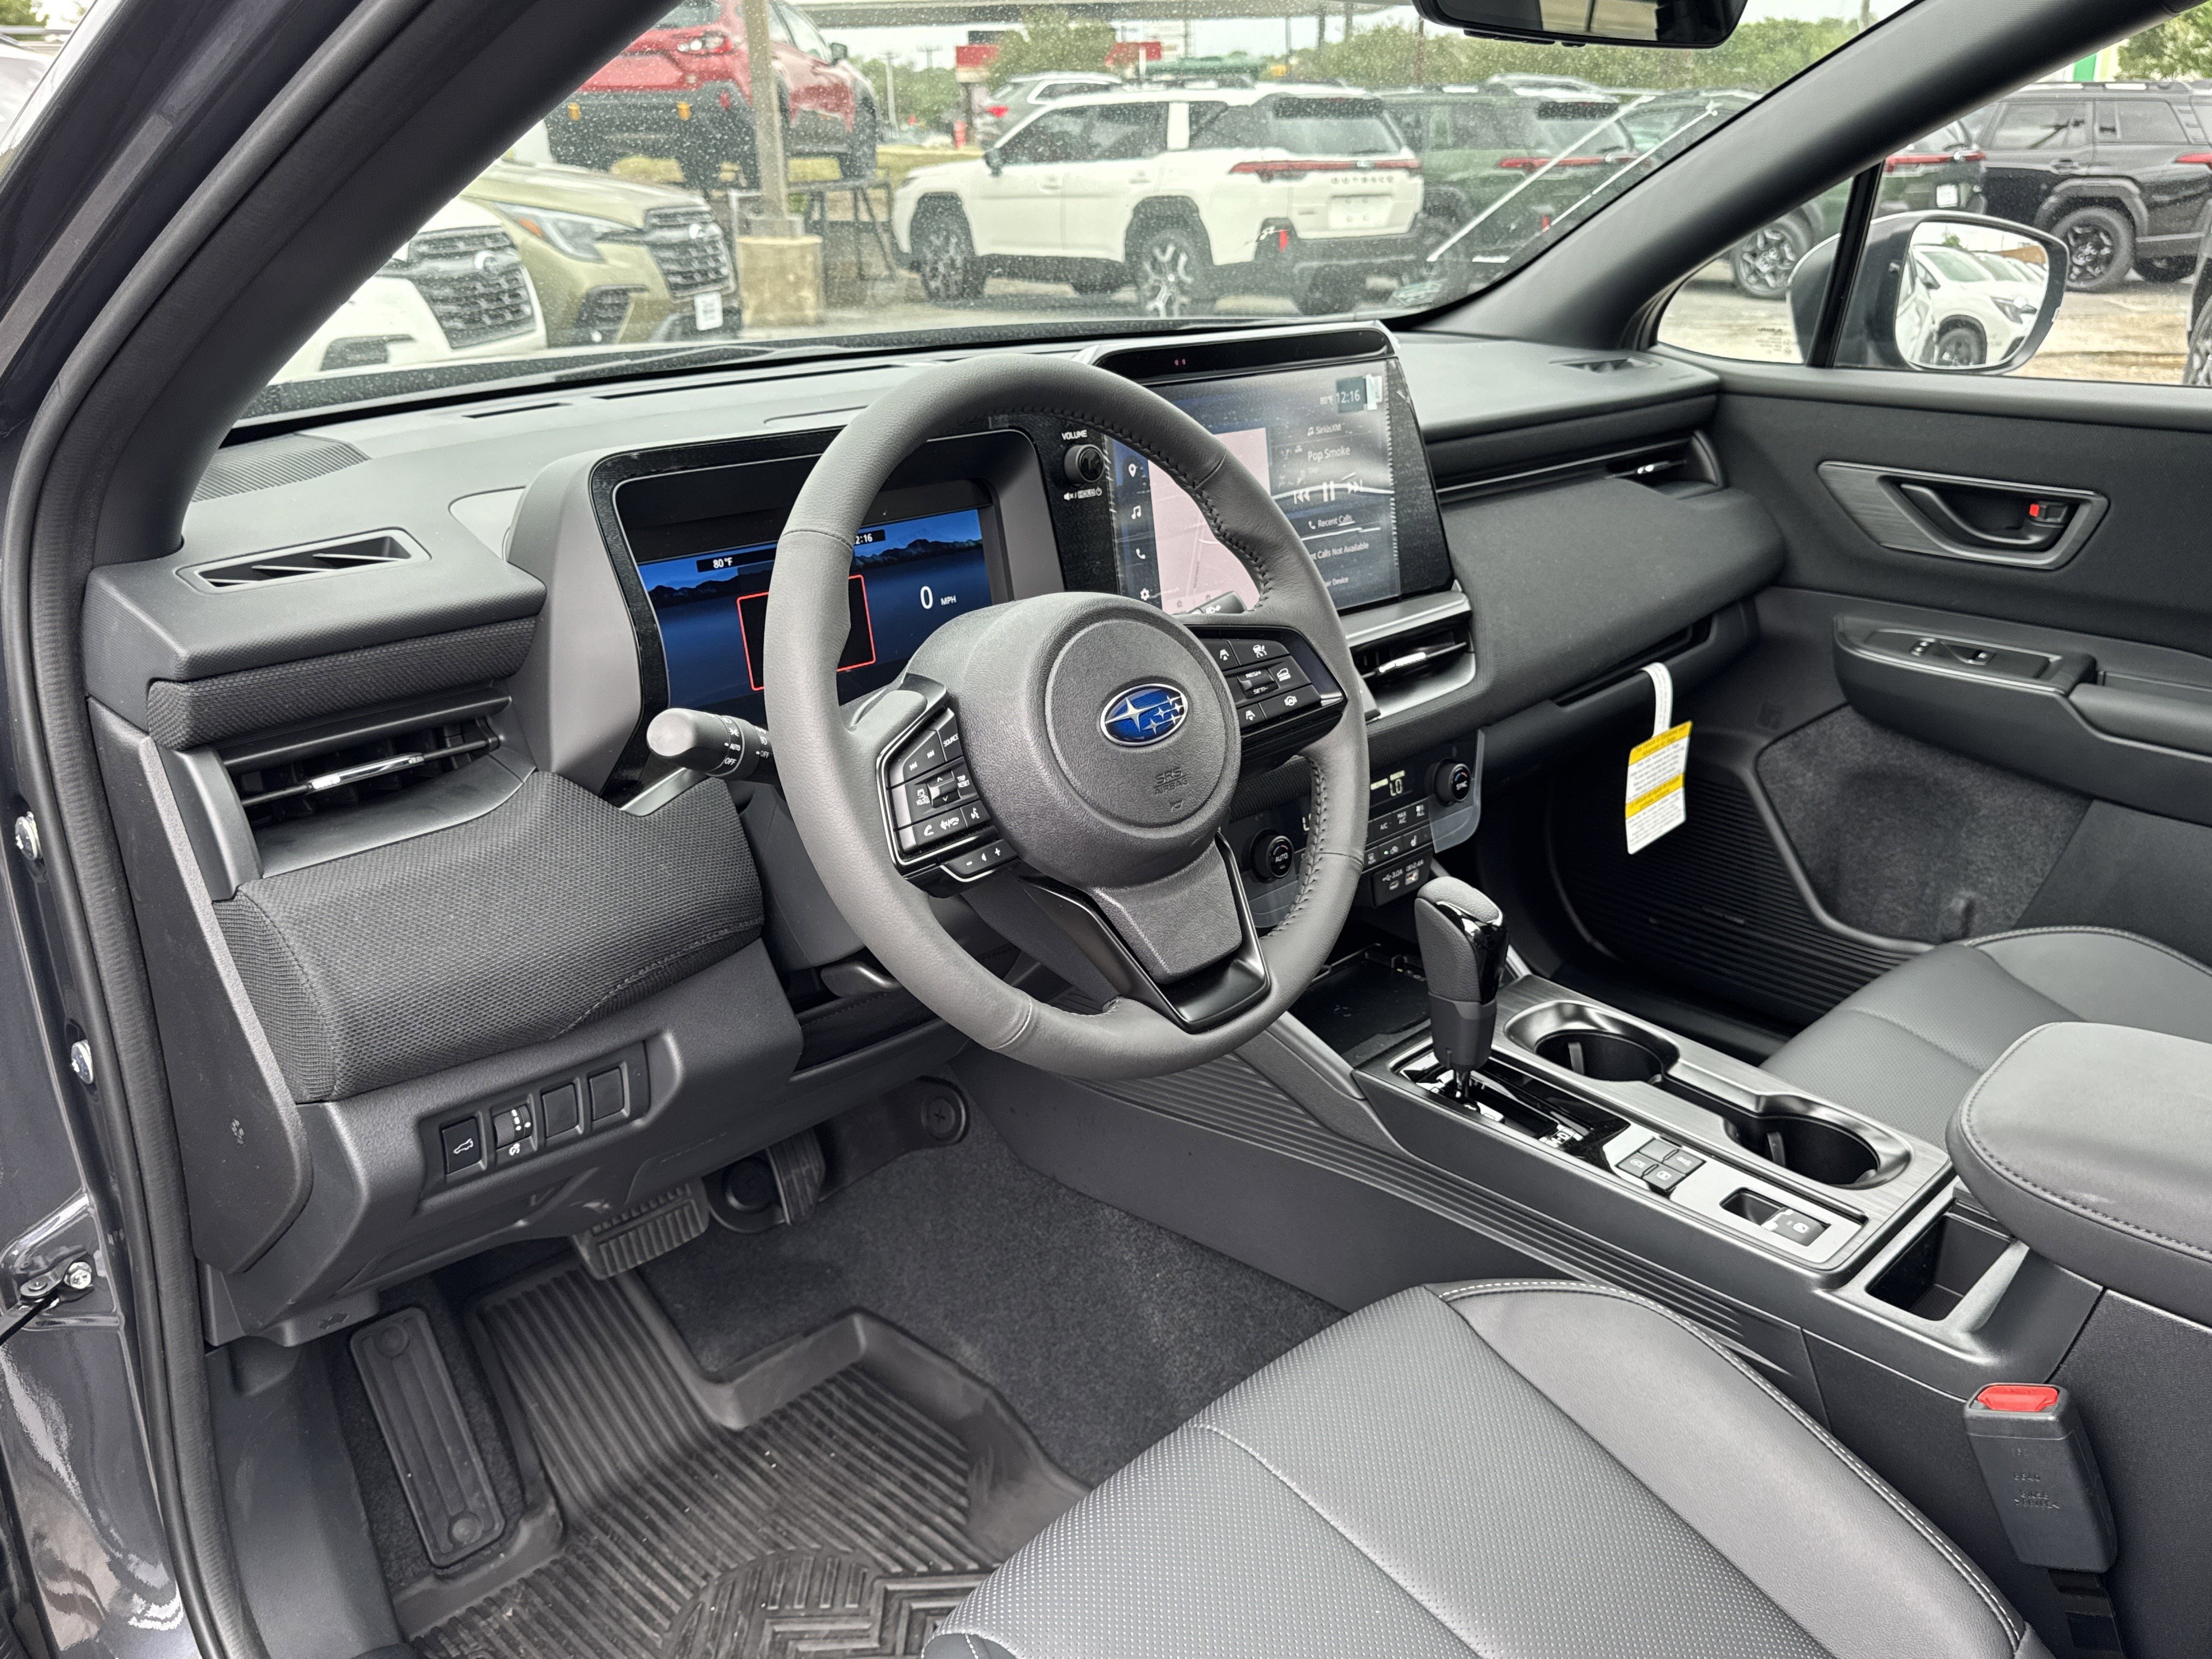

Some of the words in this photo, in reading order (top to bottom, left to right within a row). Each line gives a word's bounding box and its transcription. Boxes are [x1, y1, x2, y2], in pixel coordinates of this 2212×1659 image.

[1335, 389, 1361, 404] 12:16
[1061, 430, 1088, 440] VOLUME
[1307, 450, 1323, 463] Pop
[1324, 445, 1351, 459] Smoke
[1331, 547, 1343, 556] Not
[920, 585, 933, 610] 0
[940, 595, 957, 606] MPH
[943, 733, 959, 747] SOURCE
[730, 743, 741, 752] AUTO
[760, 750, 770, 759] OFF
[725, 757, 737, 766] OFF
[1155, 777, 1189, 795] AIRBAG
[1390, 778, 1403, 797] LO
[1275, 852, 1288, 862] AUTO
